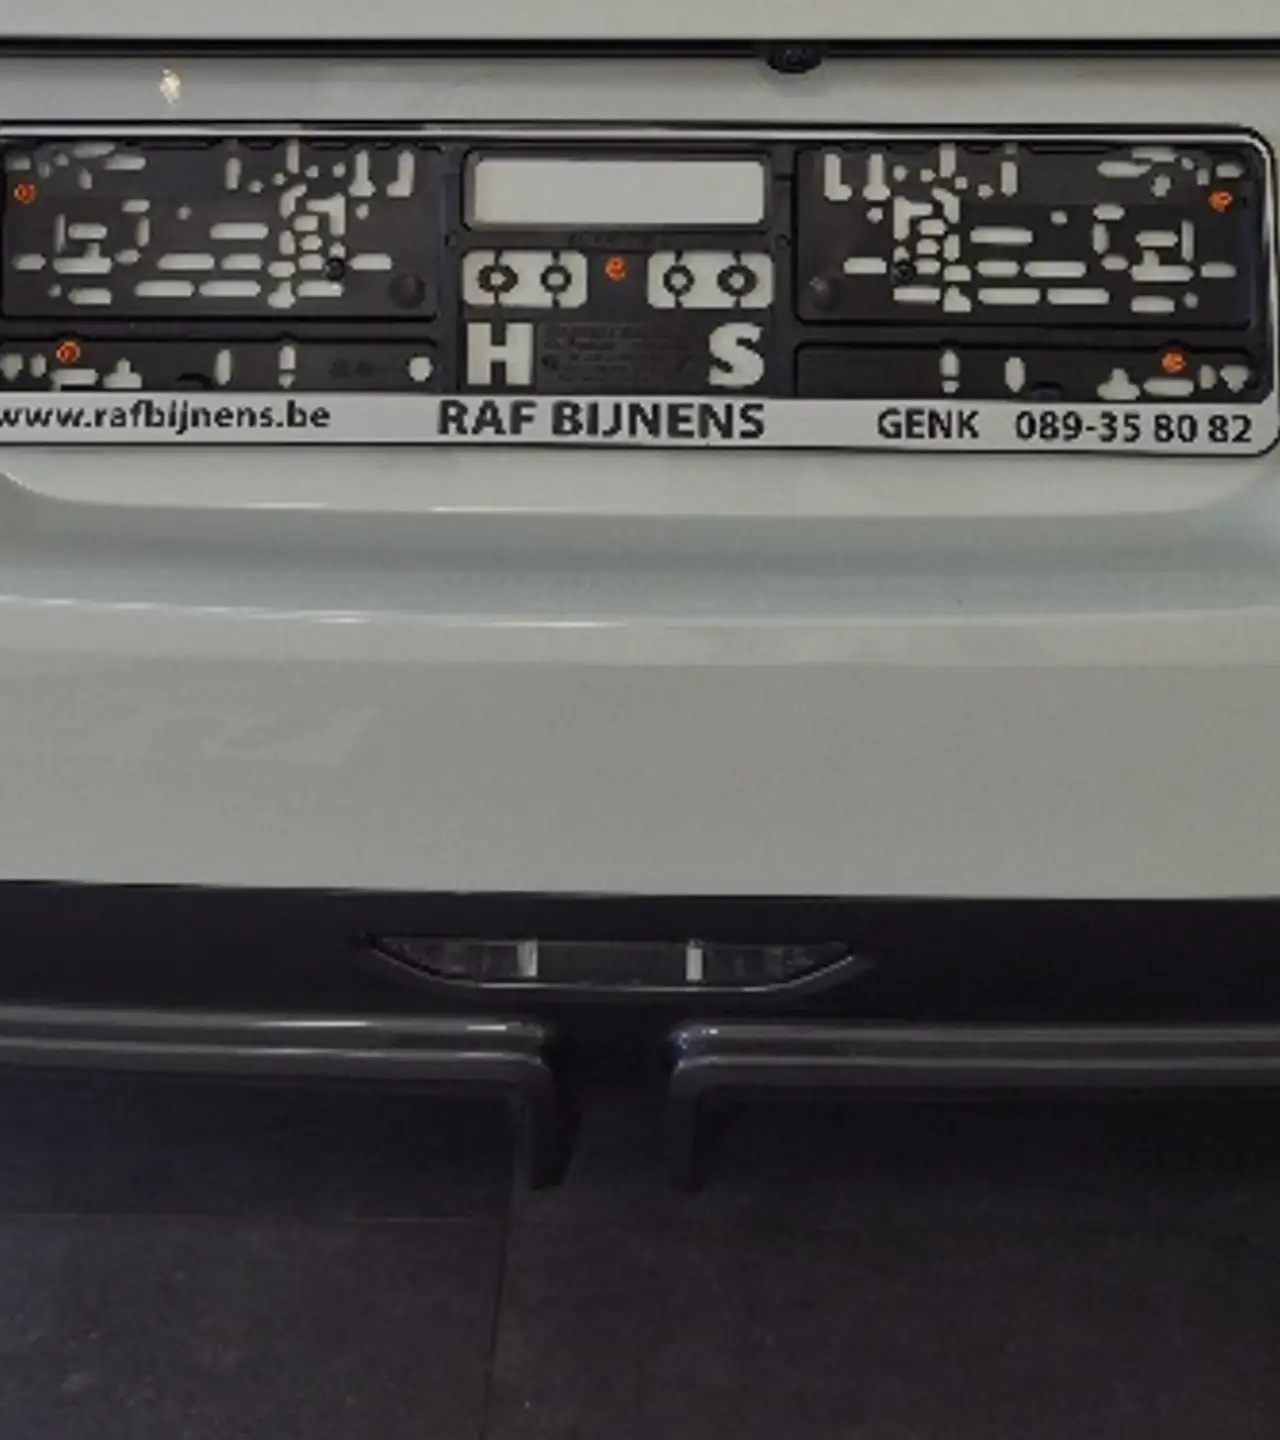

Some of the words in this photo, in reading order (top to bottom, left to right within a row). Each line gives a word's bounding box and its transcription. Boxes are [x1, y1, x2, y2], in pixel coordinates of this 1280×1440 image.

[438, 399, 537, 436] RAF
[552, 401, 766, 440] BIJNENS
[876, 406, 980, 440] GENK
[1015, 410, 1142, 443] 089-35
[1153, 413, 1198, 444] 80
[1207, 414, 1253, 444] 82
